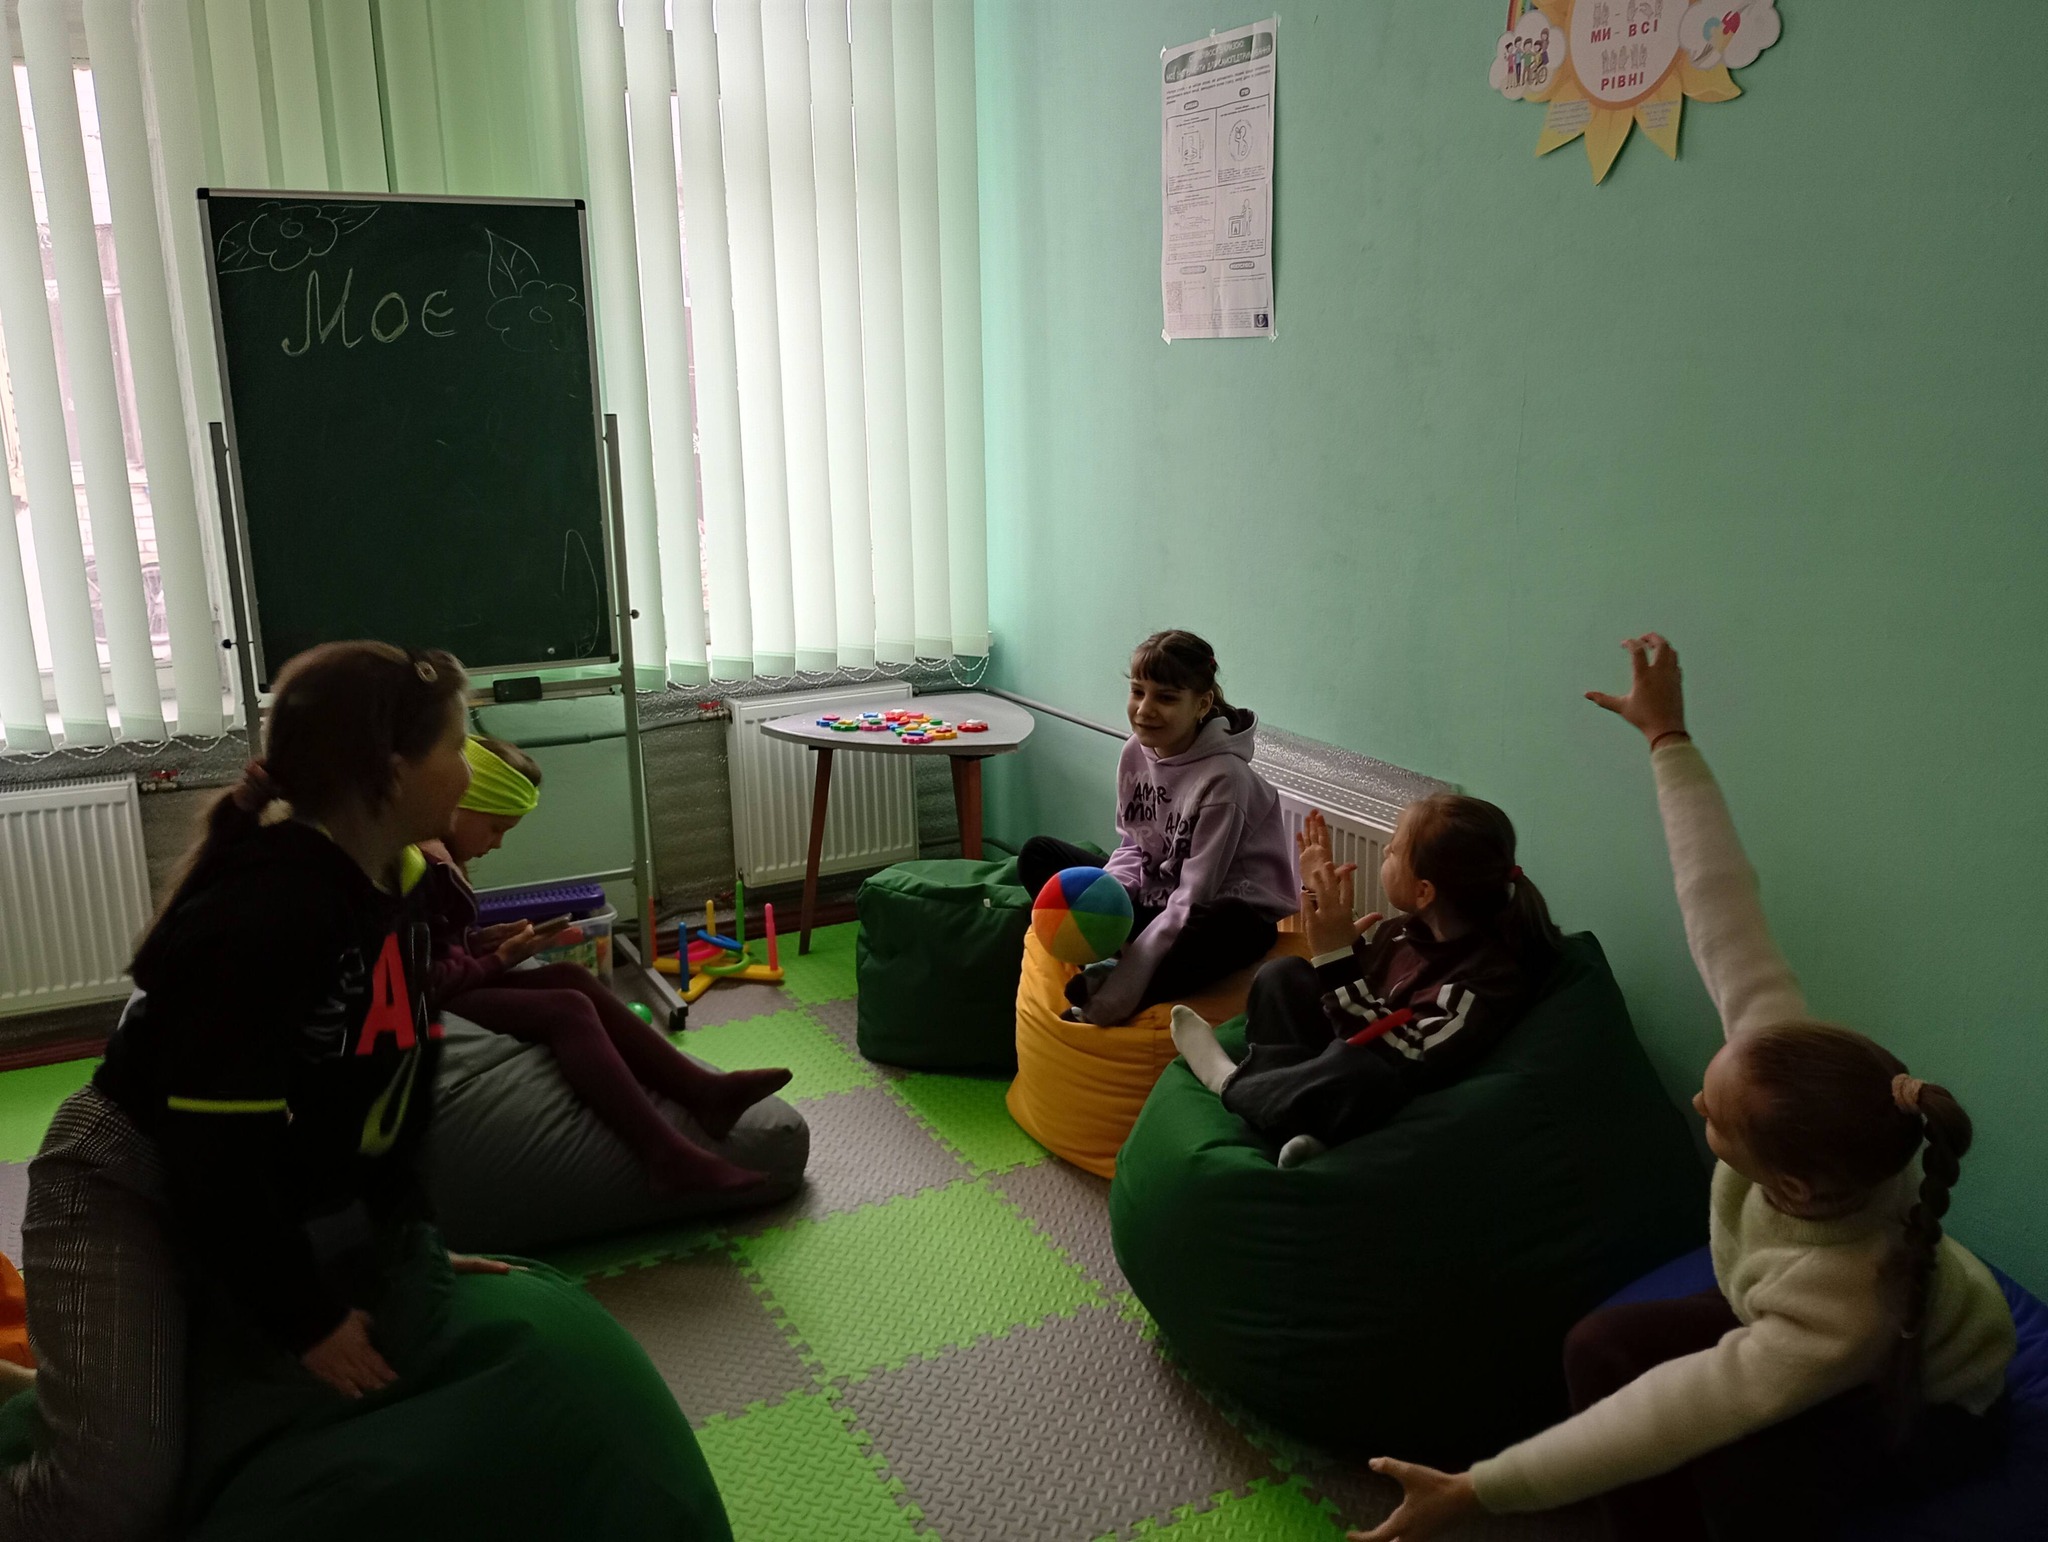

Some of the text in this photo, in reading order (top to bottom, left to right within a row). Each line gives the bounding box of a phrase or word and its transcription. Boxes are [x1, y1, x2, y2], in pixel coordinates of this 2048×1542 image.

[1591, 27, 1611, 43] МИ
[1628, 19, 1658, 37] ВСІ
[1601, 72, 1644, 91] РІВНІ
